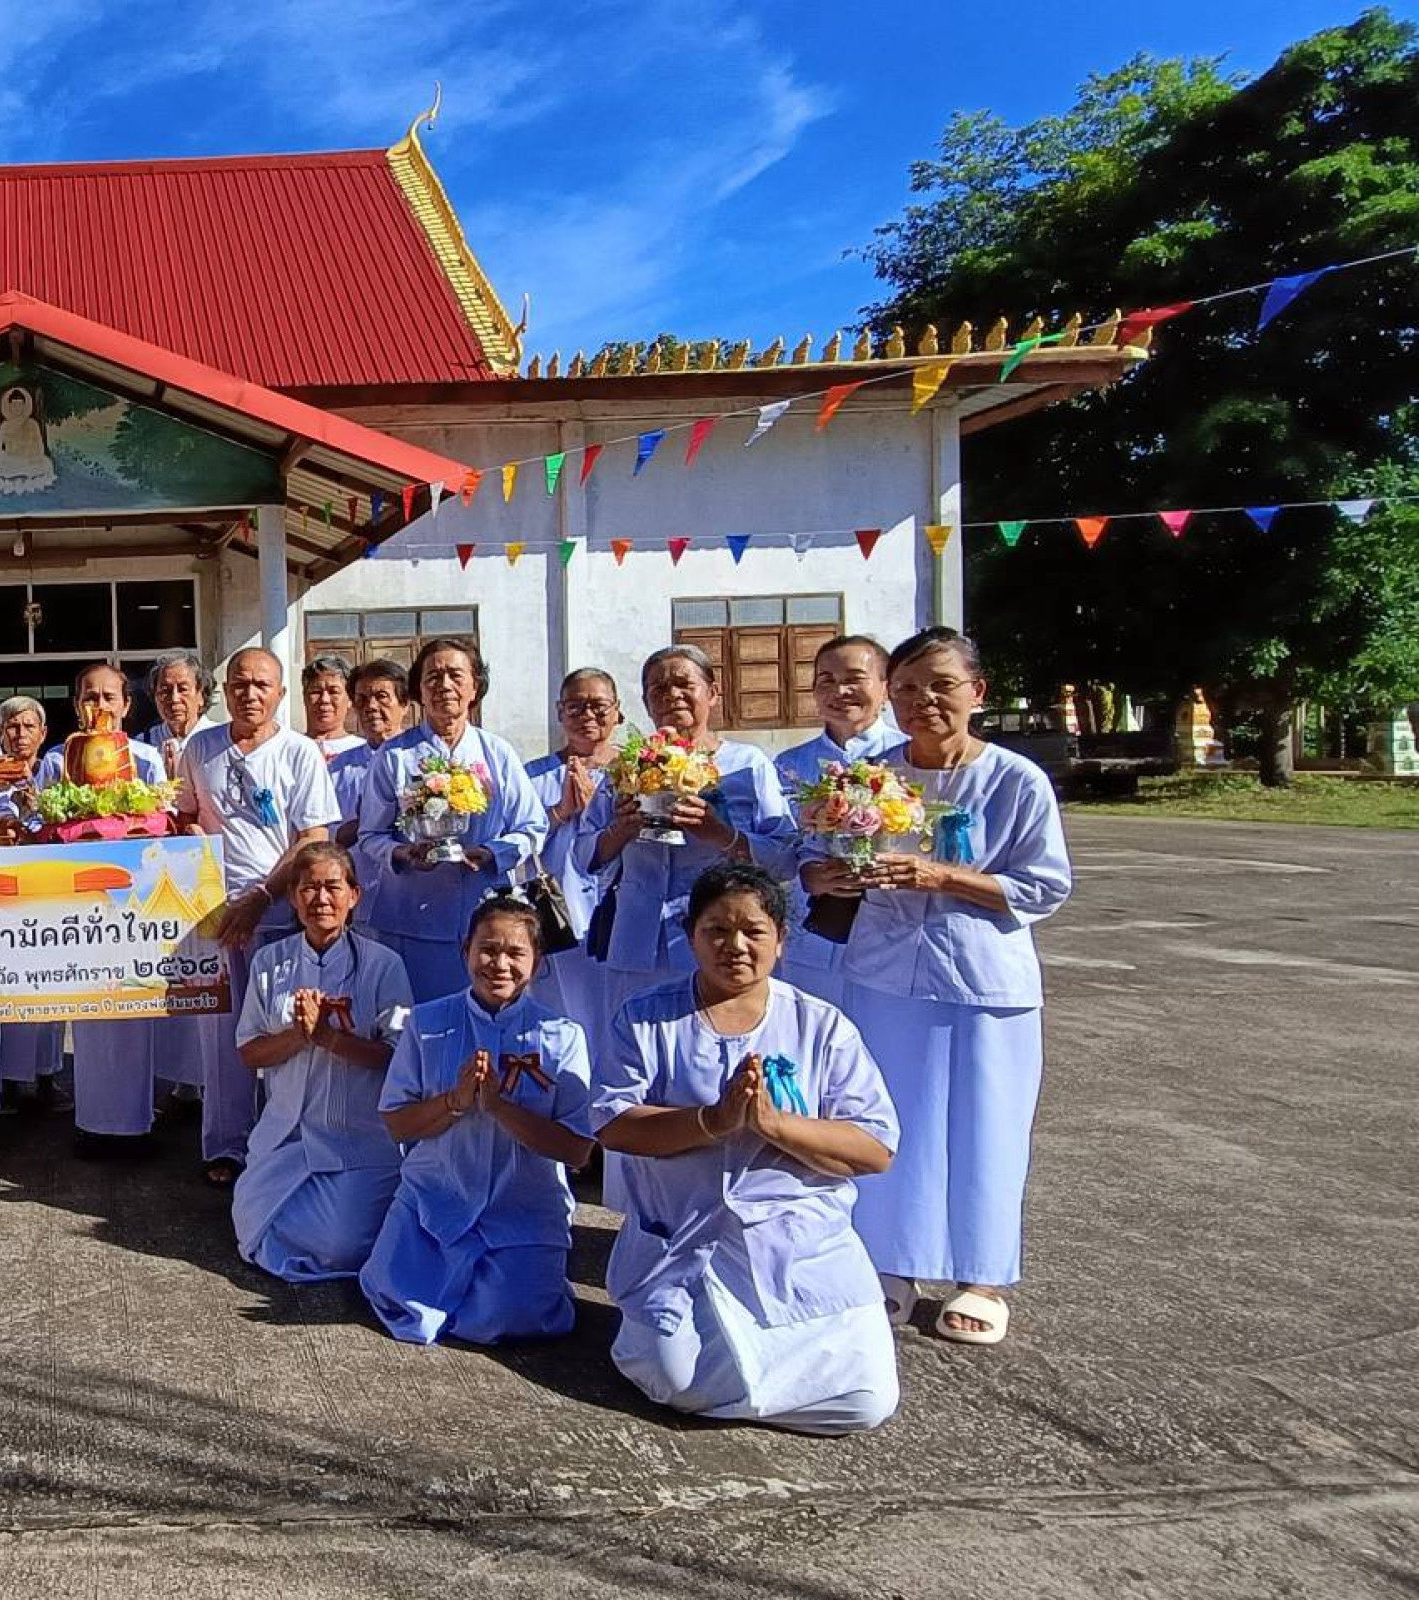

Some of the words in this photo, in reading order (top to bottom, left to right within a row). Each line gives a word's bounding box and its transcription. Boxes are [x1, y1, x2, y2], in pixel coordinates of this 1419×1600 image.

[25, 962, 125, 989] พุทธศักราช
[133, 954, 220, 979] ๒๕๖๘
